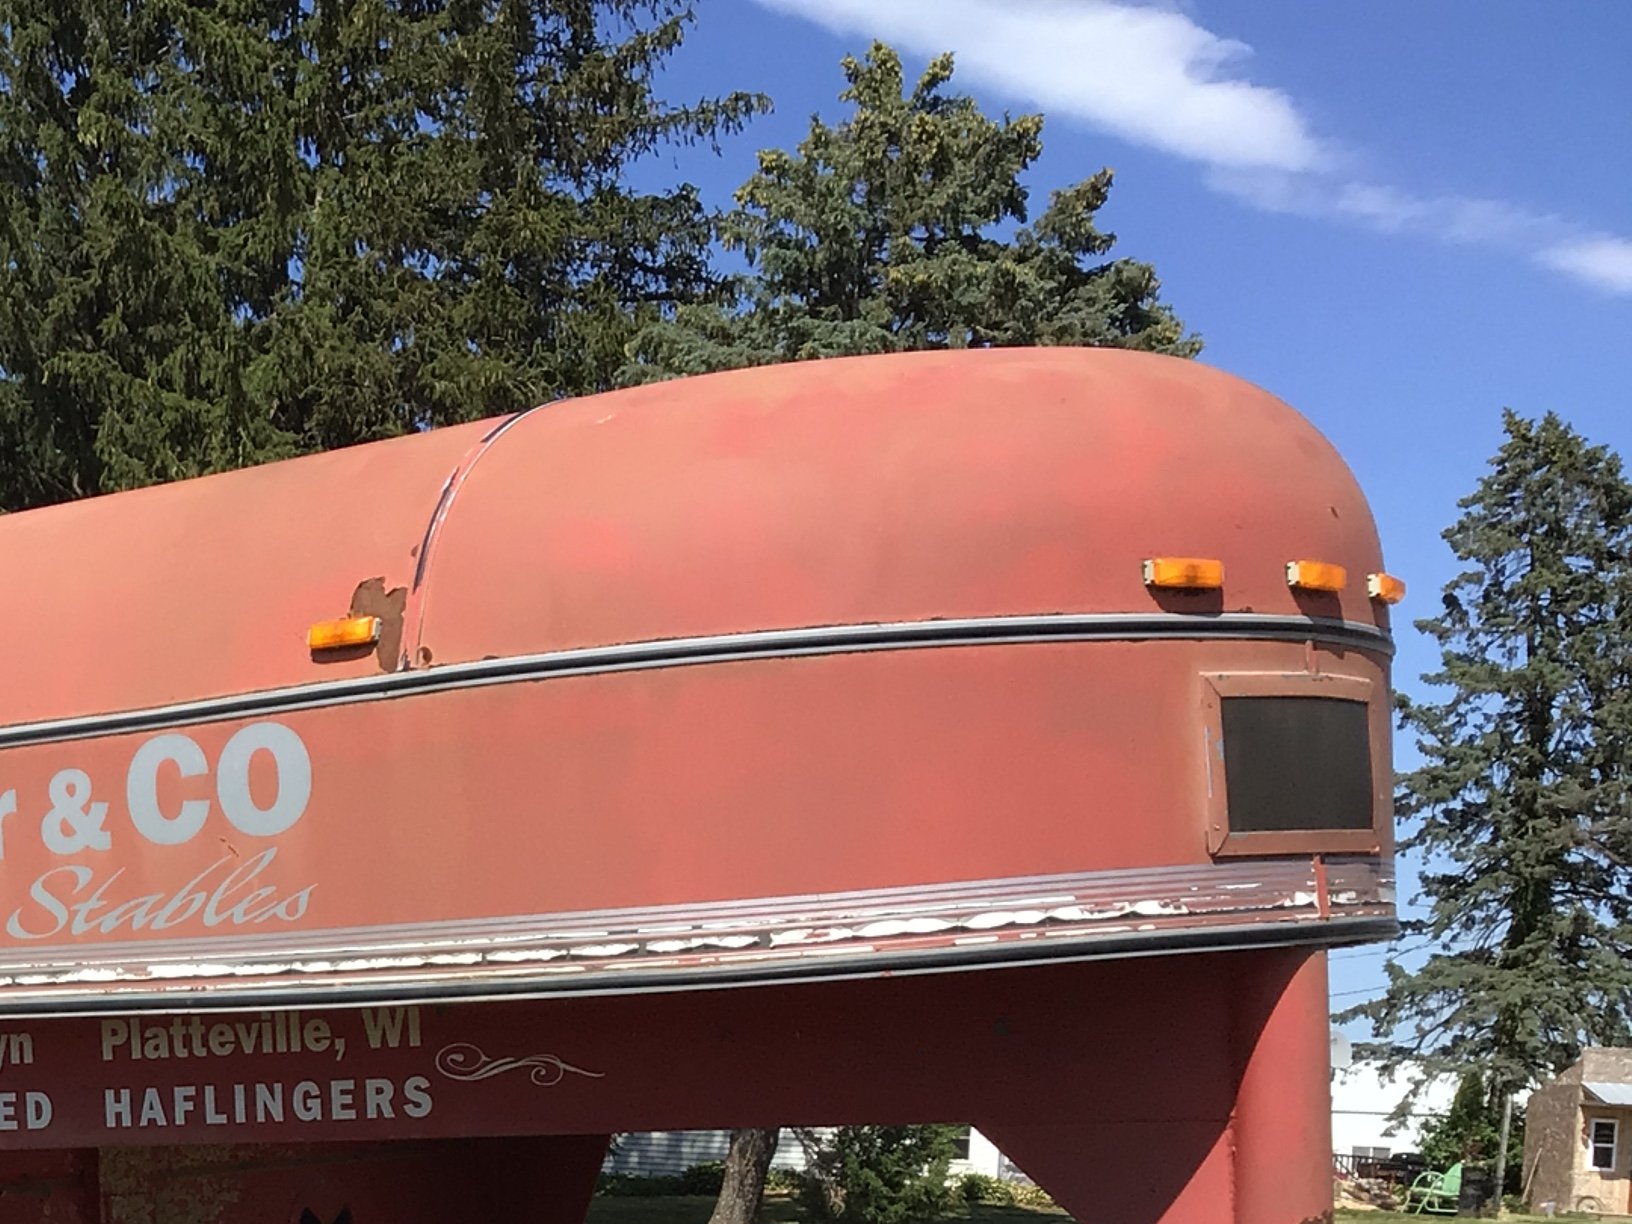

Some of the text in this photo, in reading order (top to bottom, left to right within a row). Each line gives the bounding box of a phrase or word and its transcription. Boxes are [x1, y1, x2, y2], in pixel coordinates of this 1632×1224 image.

[41, 768, 112, 855] &
[126, 721, 313, 846] CO
[6, 846, 320, 941] Stables
[100, 1006, 422, 1062] Platteville, WI
[104, 1076, 433, 1129] HAFLINGERS
